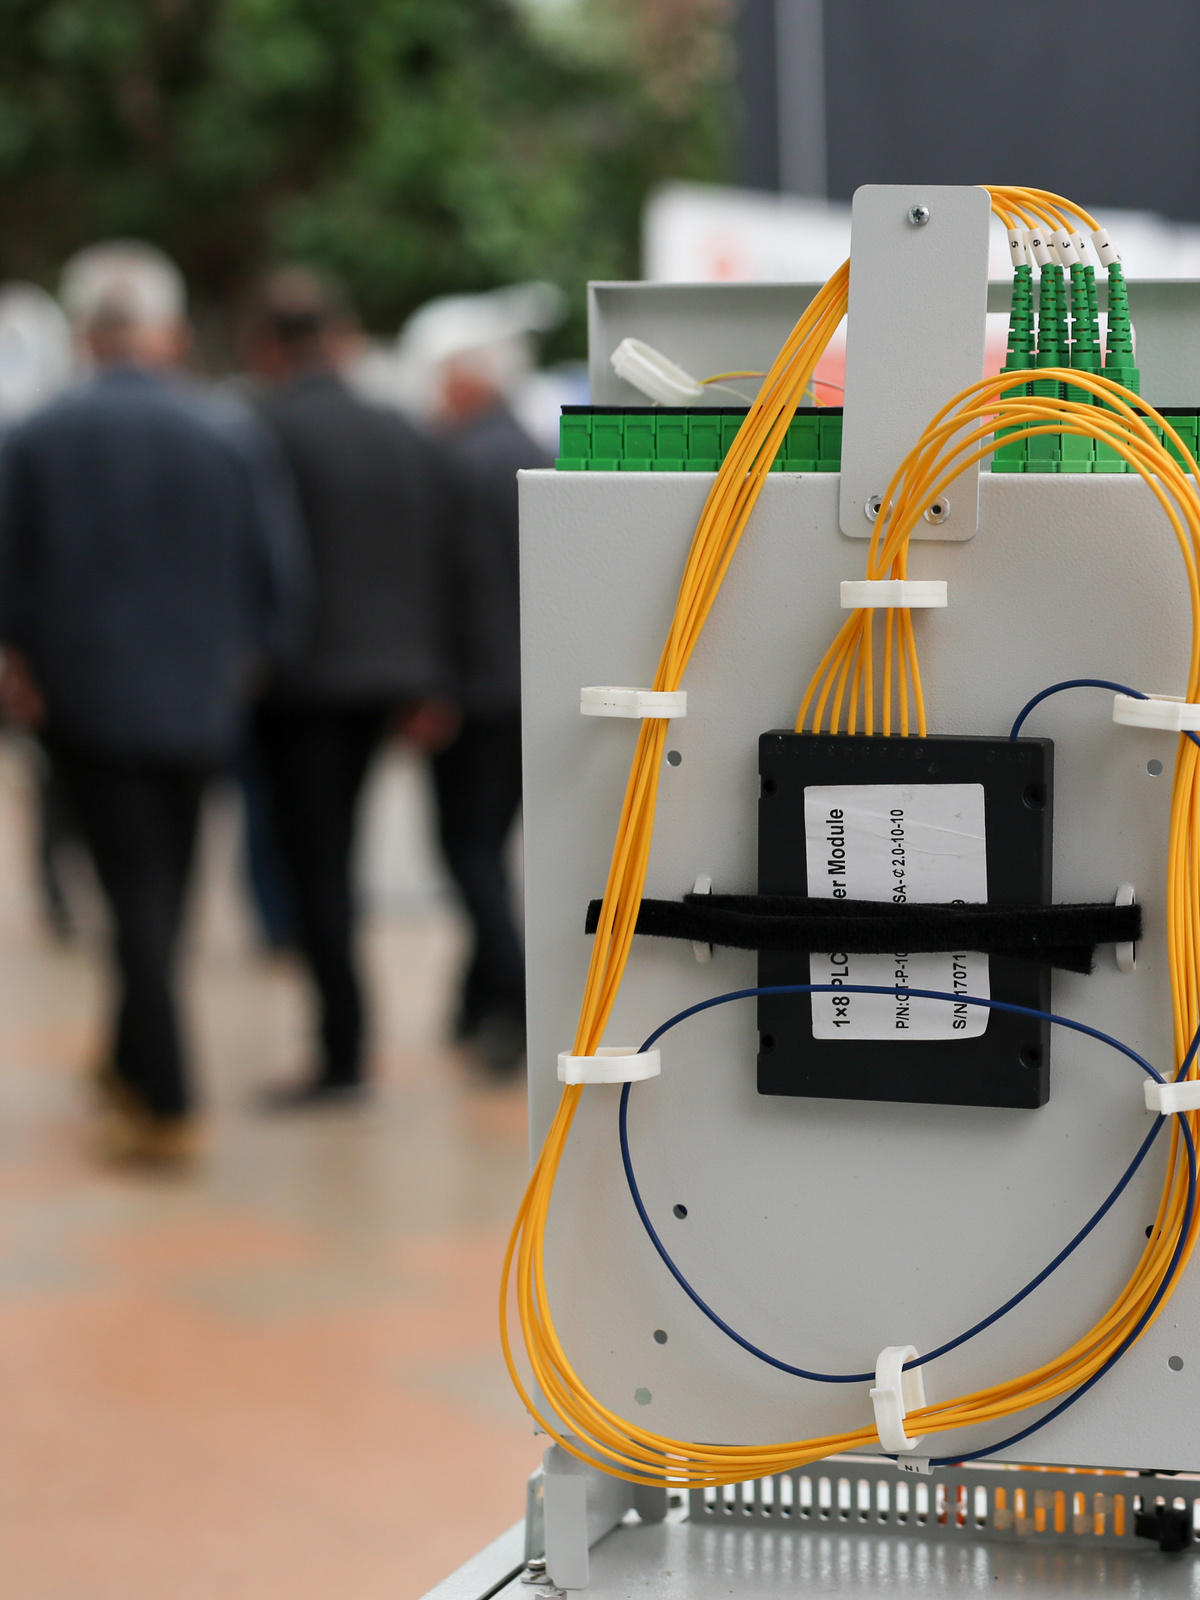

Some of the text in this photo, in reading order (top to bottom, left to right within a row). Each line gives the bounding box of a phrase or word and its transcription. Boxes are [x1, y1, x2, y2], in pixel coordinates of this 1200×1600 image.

[1011, 240, 1019, 248] 5
[1033, 239, 1041, 247] 6
[826, 808, 846, 875] Module
[830, 952, 849, 985] PLC
